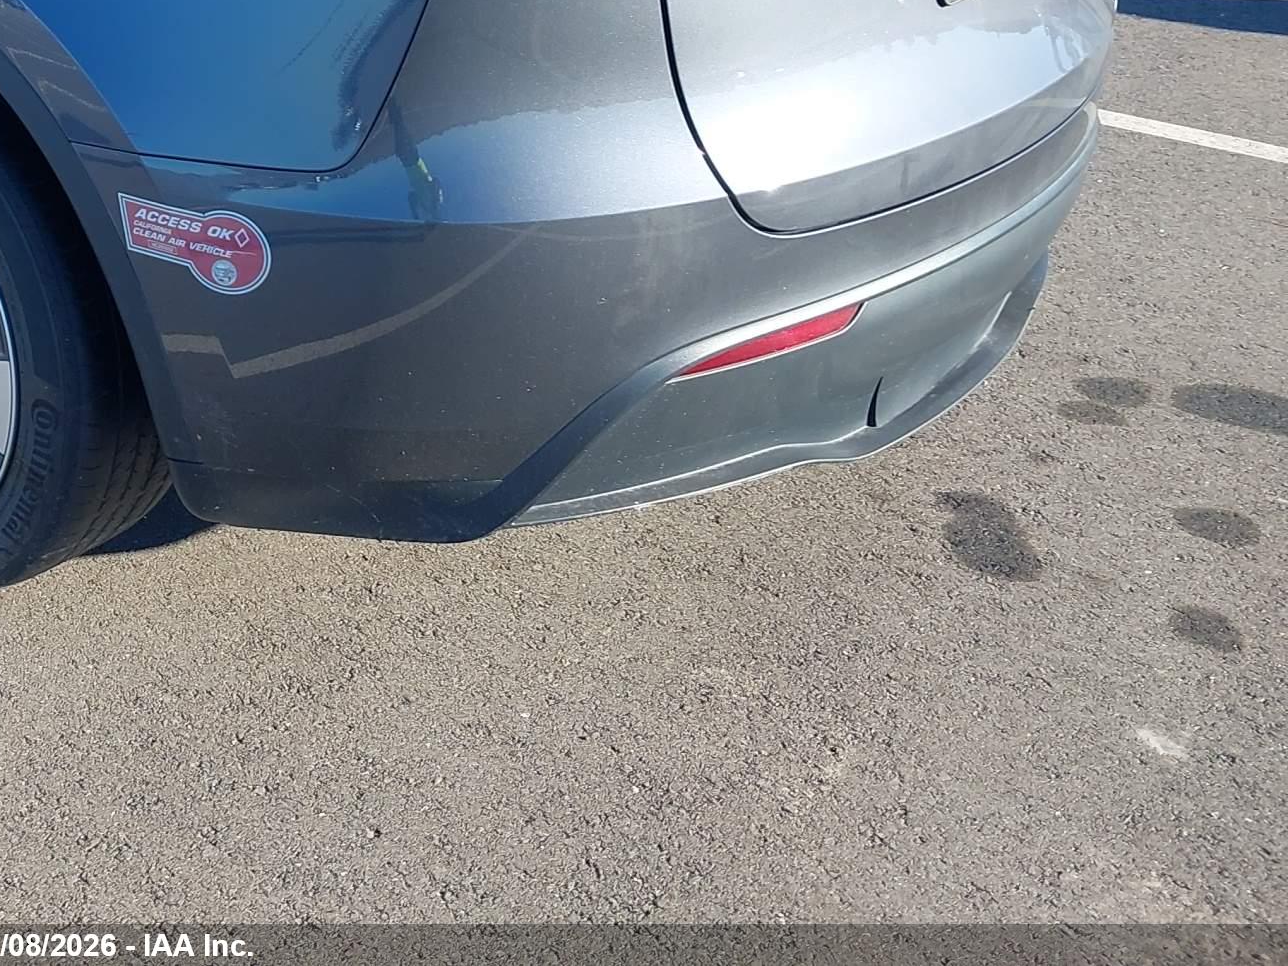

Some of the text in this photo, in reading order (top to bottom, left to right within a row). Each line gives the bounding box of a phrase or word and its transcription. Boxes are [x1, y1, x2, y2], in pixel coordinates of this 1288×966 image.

[134, 208, 235, 241] ACCESS OK
[132, 227, 167, 242] CLEAN
[168, 237, 187, 248] AIR
[189, 242, 233, 259] VEHICLE
[1, 398, 60, 544] Continental
